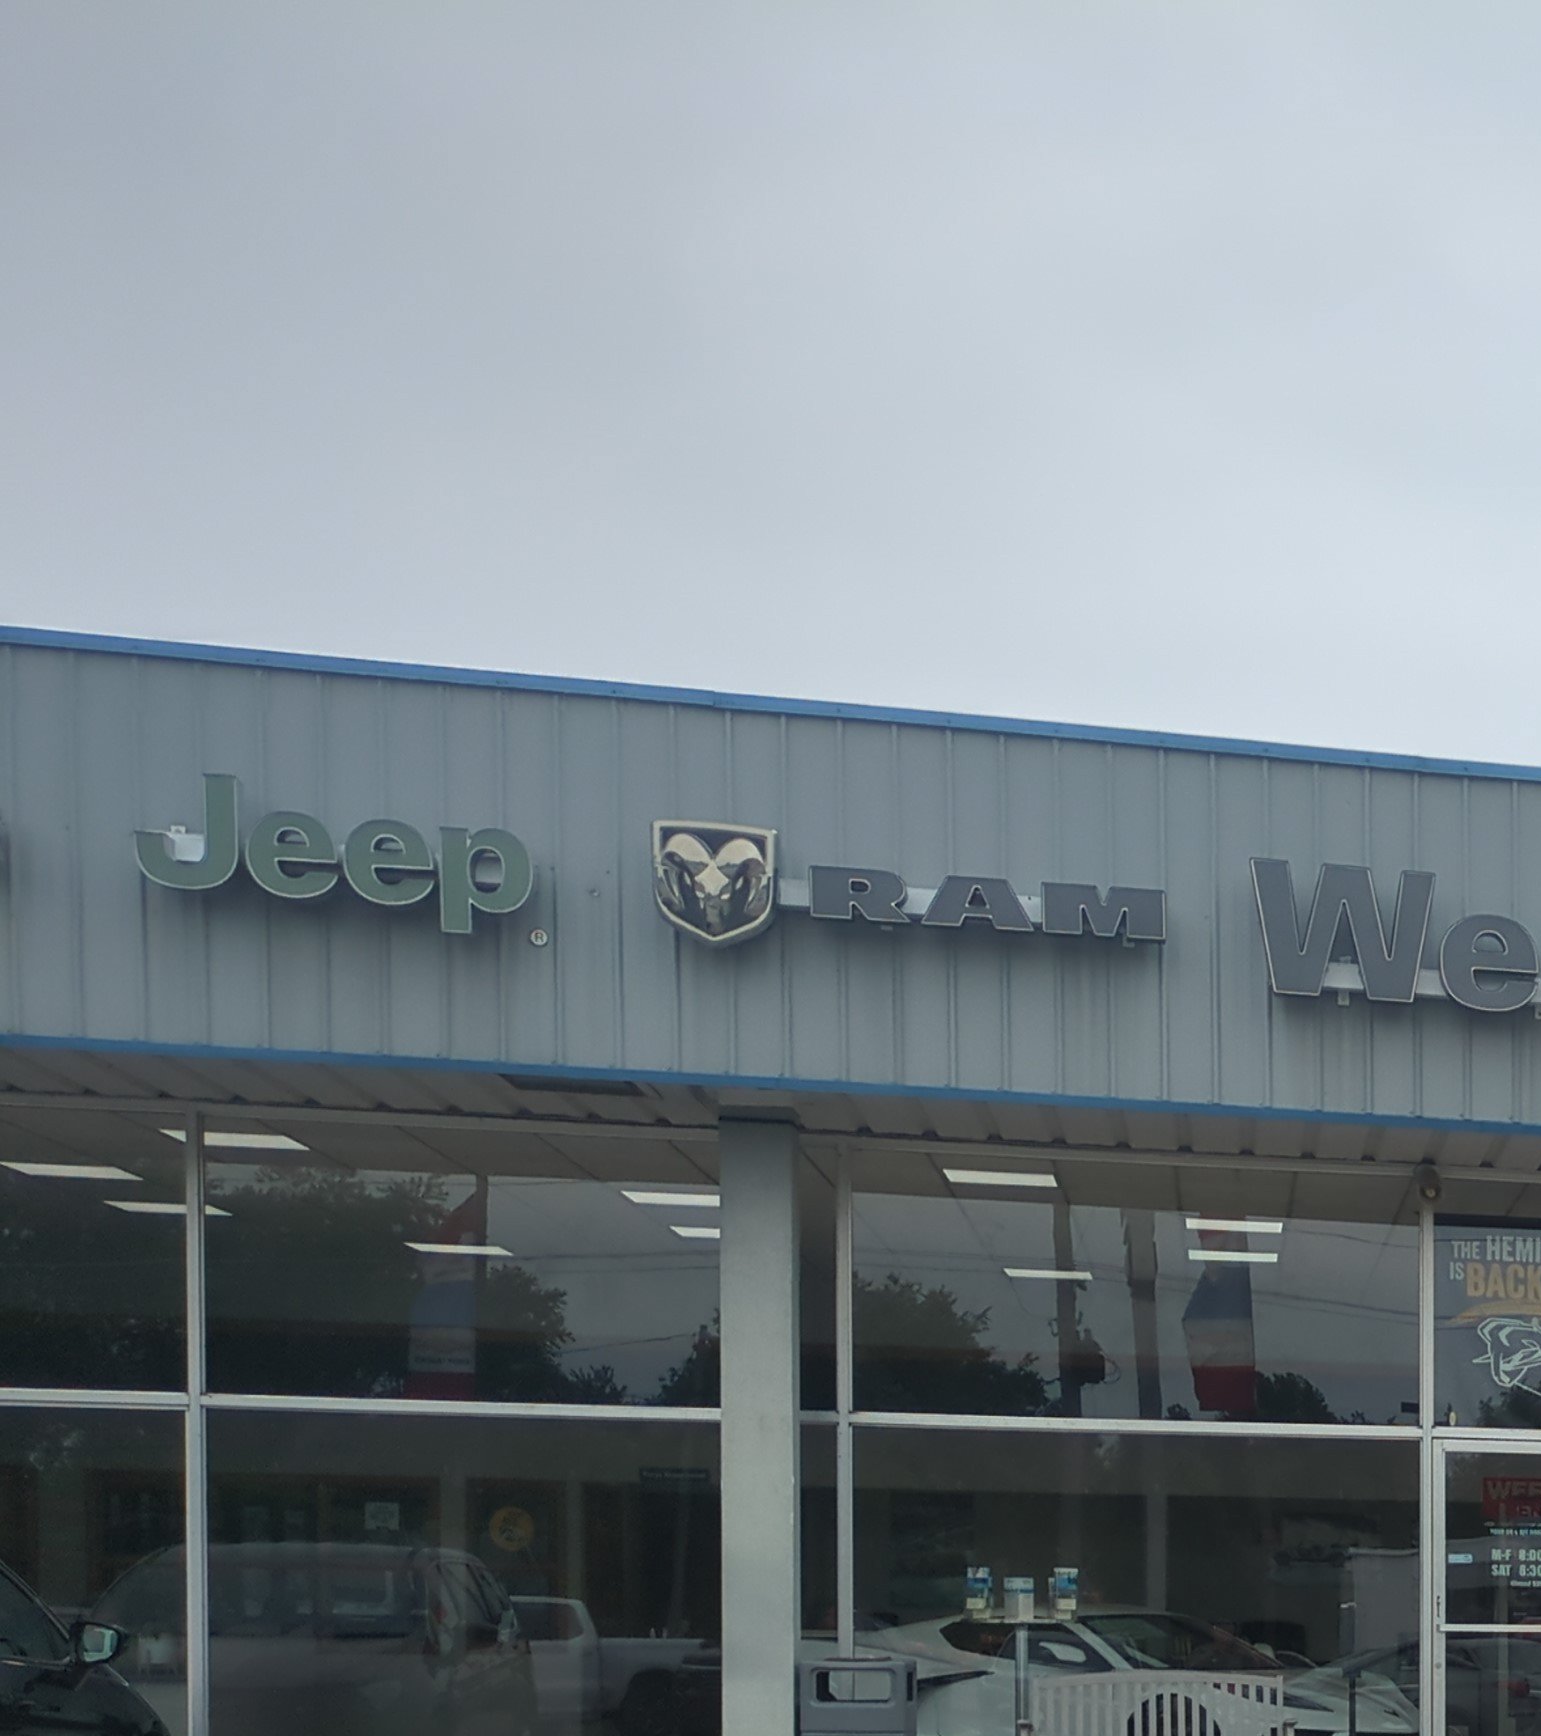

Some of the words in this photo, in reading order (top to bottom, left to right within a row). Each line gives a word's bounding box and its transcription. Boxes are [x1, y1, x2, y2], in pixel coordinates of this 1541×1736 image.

[134, 774, 533, 934] Jeep
[808, 865, 1167, 943] RAM
[1451, 1240, 1481, 1260] THE
[1450, 1262, 1465, 1280] IS
[1491, 1564, 1512, 1577] SAT
